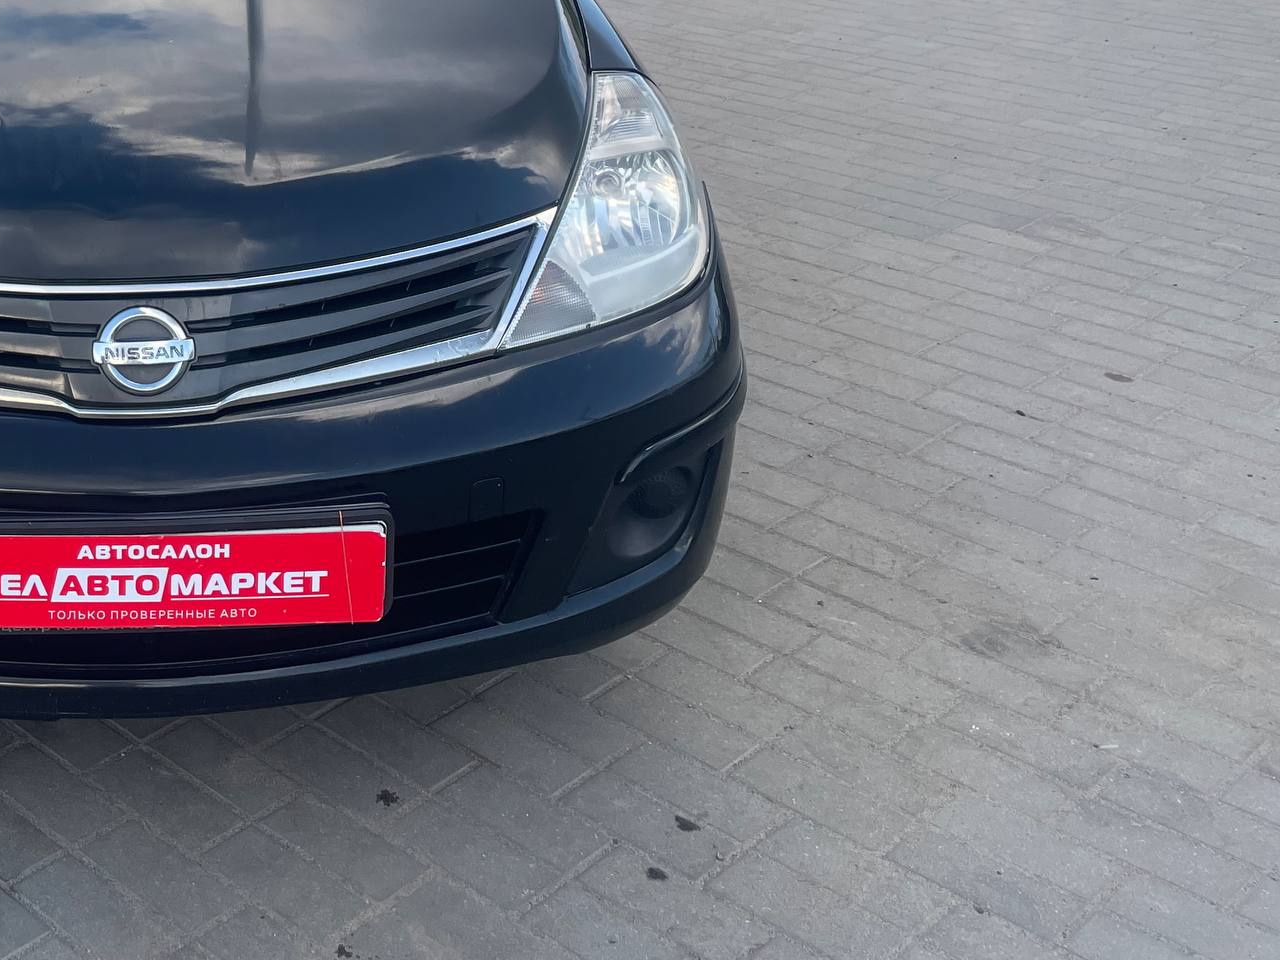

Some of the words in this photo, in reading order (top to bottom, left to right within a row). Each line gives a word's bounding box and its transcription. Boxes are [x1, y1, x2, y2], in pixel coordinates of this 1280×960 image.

[104, 344, 184, 361] NISSAN
[76, 543, 231, 561] АВТОСАЛОН
[48, 609, 107, 621] ТОЛЬКО
[109, 608, 216, 621] ПРОВЕРЕННЫЕ
[219, 607, 258, 619] АВТО
